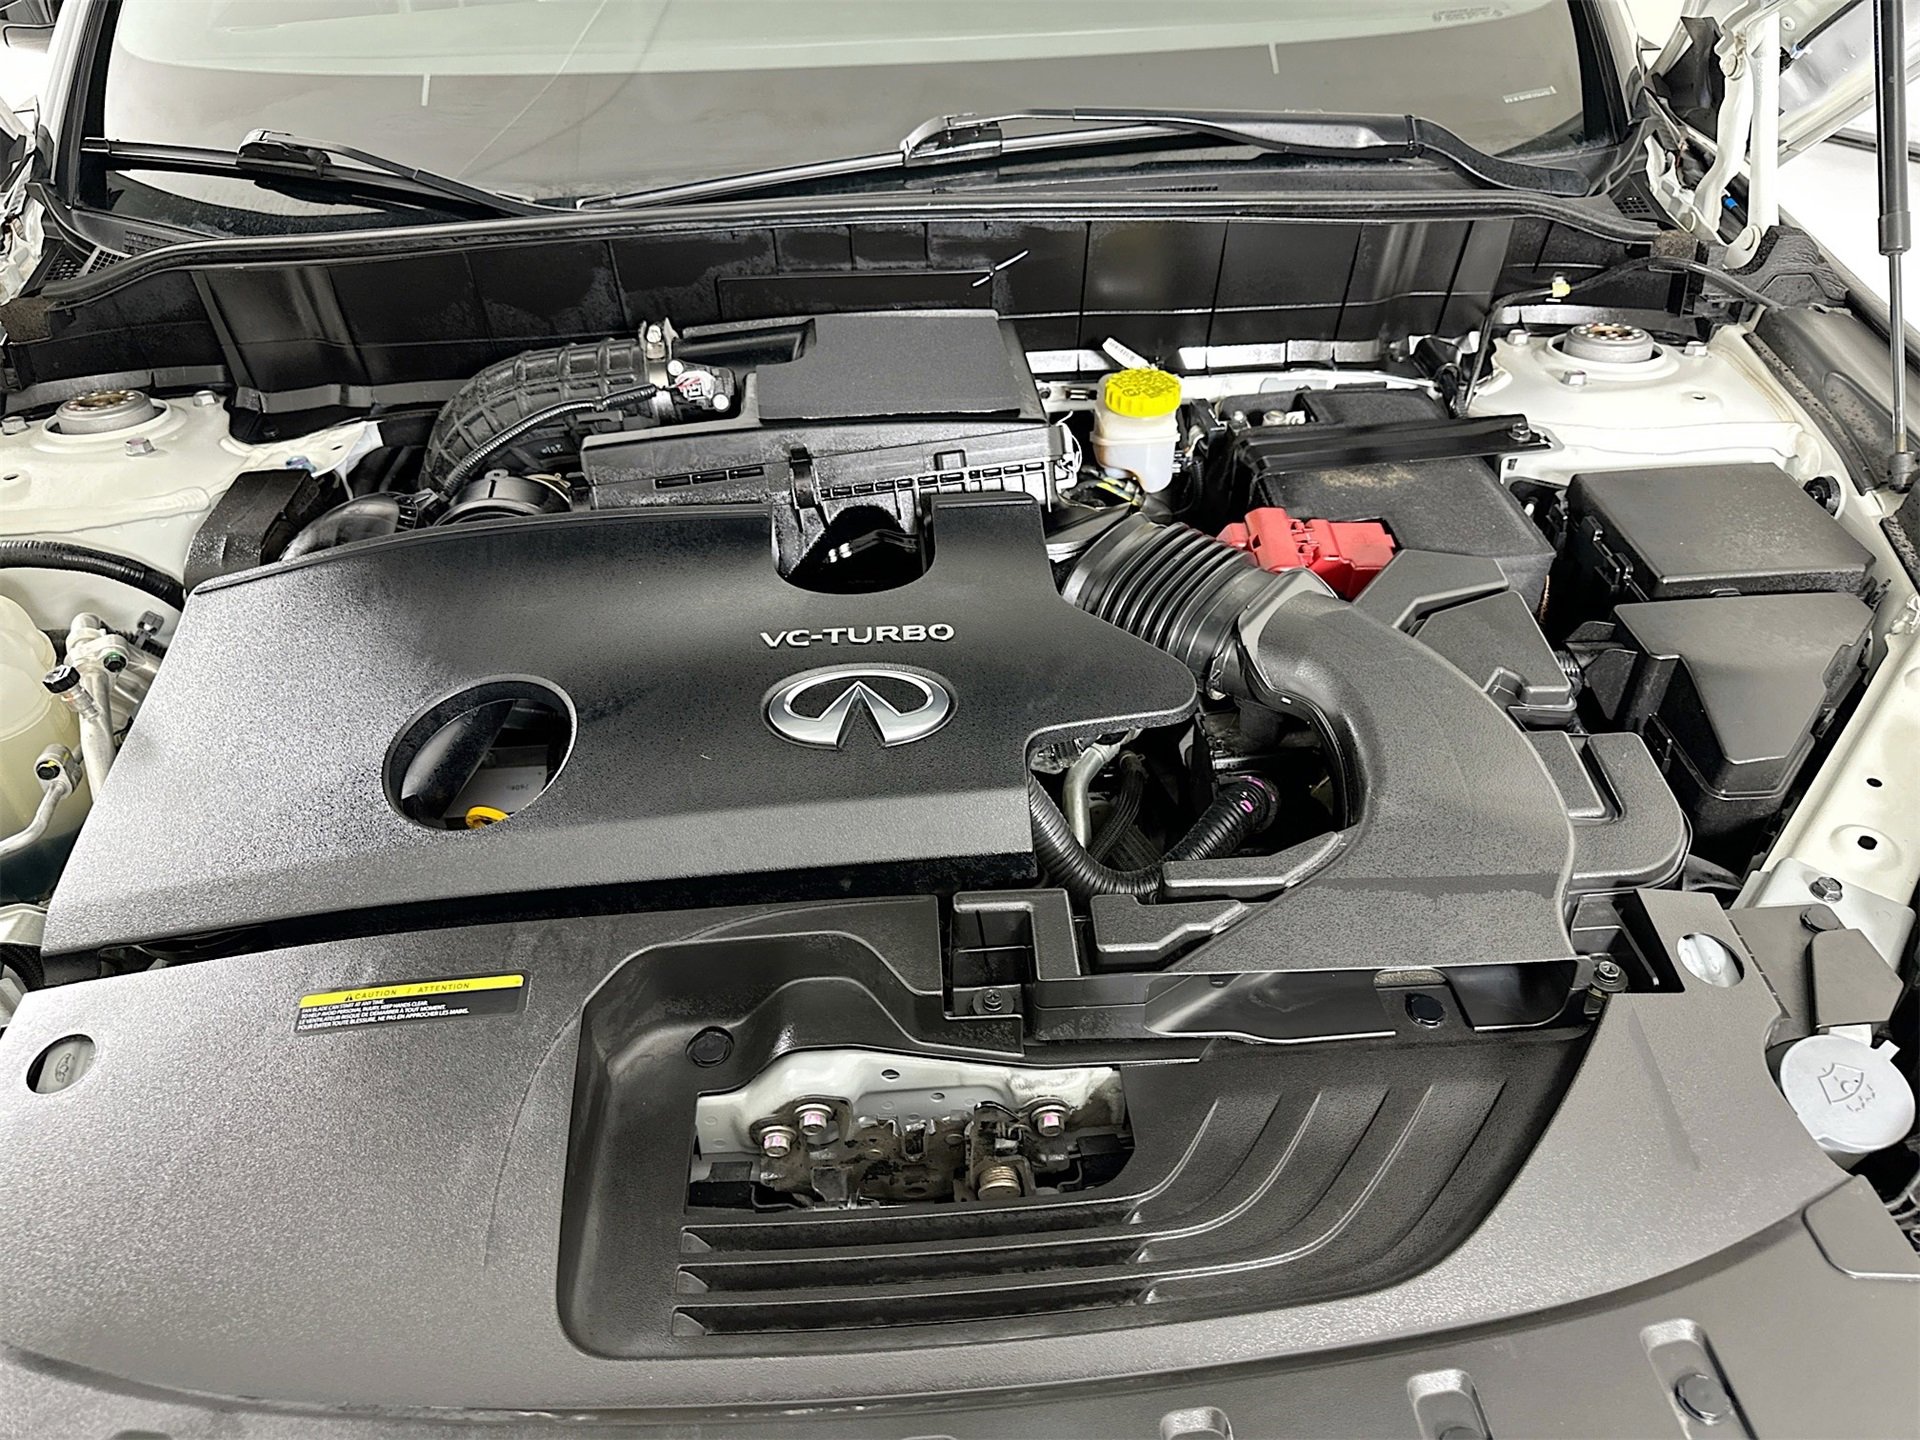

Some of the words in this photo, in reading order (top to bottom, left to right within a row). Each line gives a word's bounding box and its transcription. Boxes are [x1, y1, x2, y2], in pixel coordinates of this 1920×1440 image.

[760, 623, 955, 648] VC-TURBO
[354, 989, 397, 999] CAUTION
[417, 983, 470, 993] ATTENTION
